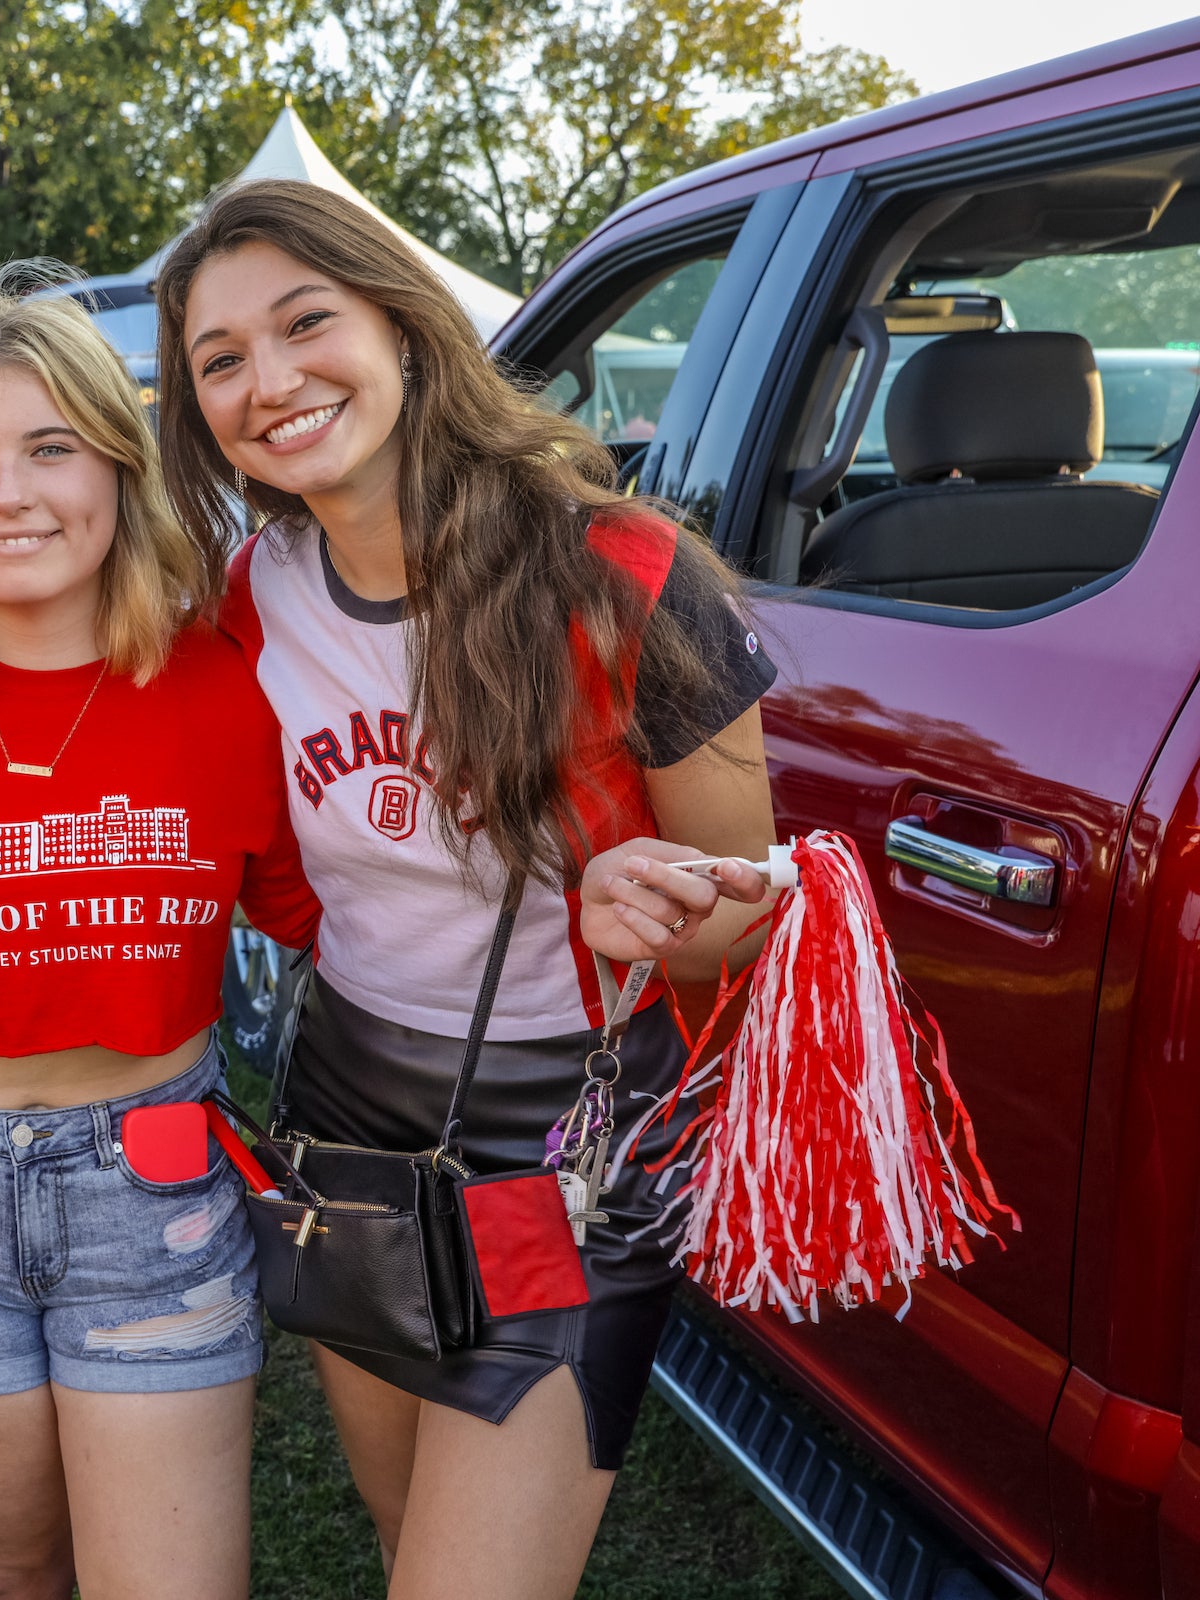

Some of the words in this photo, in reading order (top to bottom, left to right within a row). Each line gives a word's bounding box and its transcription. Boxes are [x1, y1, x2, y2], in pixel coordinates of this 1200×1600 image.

[378, 785, 408, 831] B
[60, 896, 145, 927] THE
[156, 897, 219, 925] RED
[29, 945, 115, 966] STUDENT
[122, 944, 182, 960] SENATE
